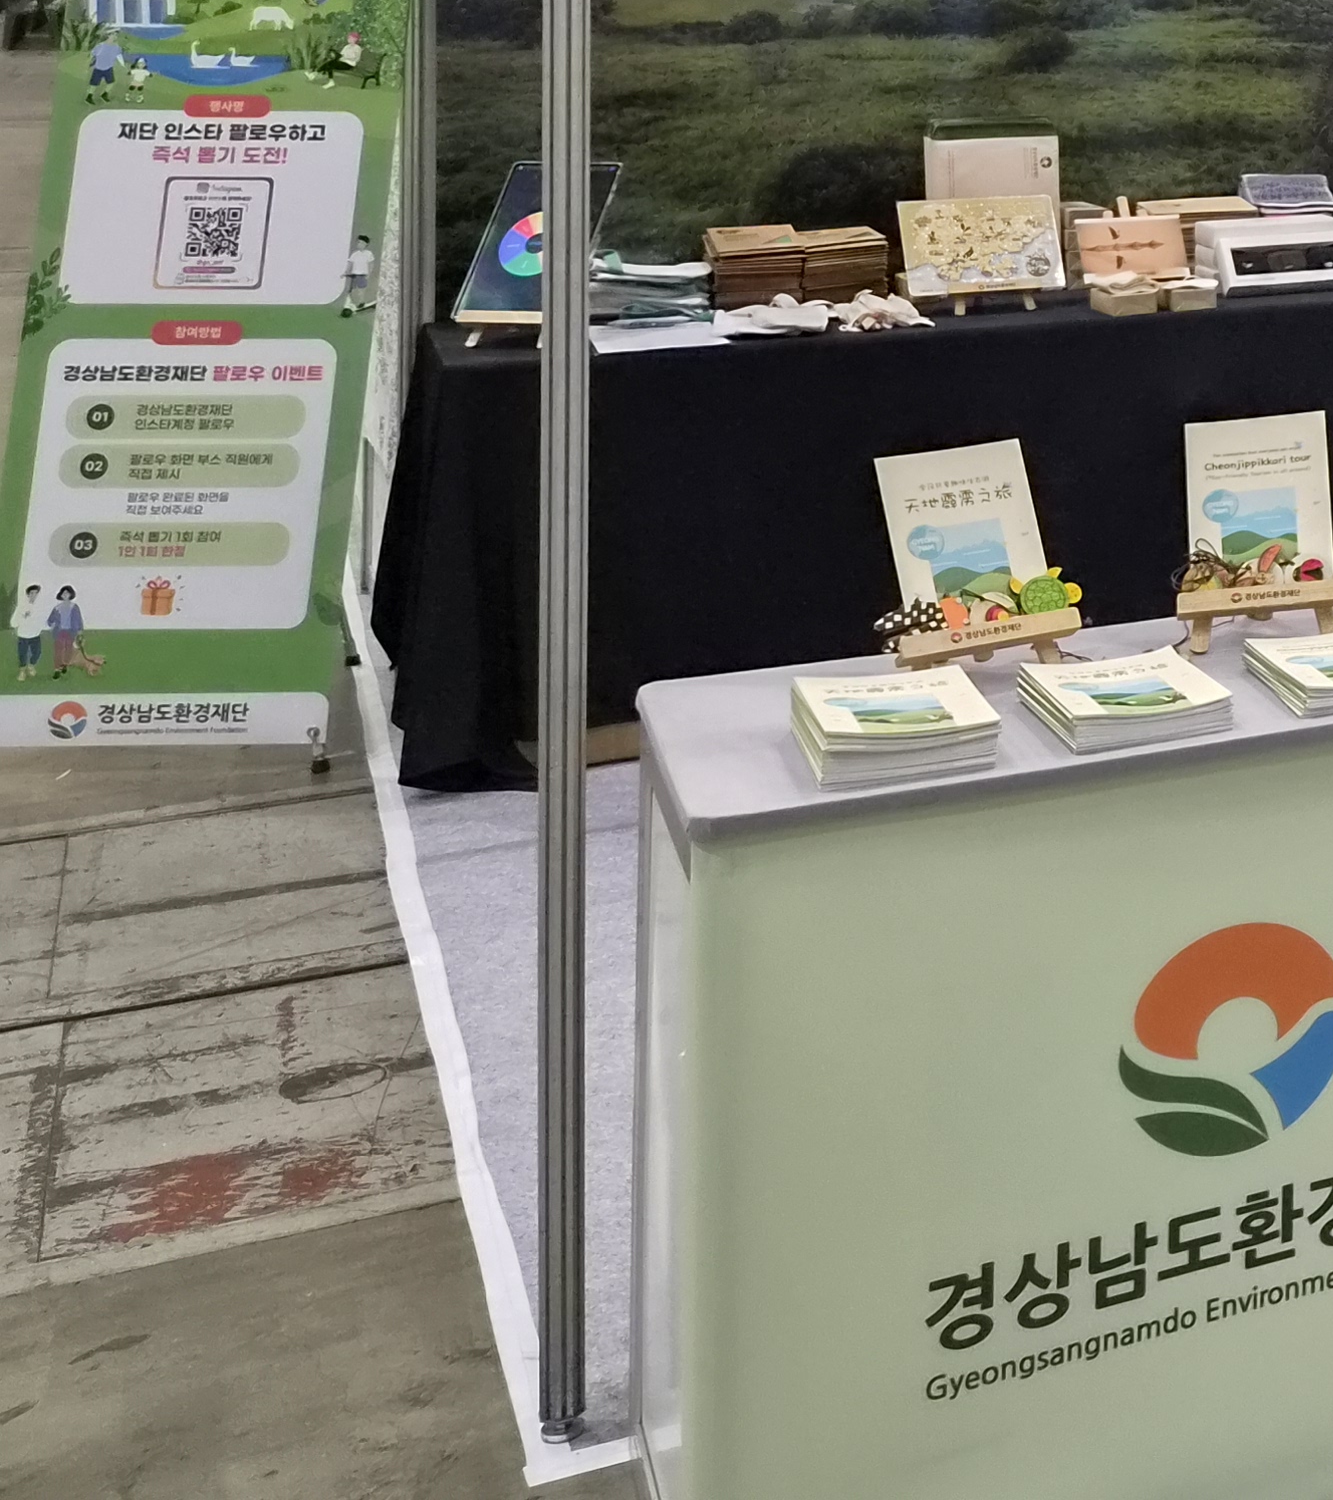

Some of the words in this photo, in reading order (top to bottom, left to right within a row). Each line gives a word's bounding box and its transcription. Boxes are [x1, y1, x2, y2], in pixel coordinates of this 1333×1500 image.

[118, 122, 159, 142] 재단
[164, 122, 224, 142] 인스타
[228, 122, 327, 142] 팔로우하고
[151, 145, 191, 164] 즉석
[242, 146, 289, 165] 도전!
[62, 364, 208, 383] 경상남도환경재단
[212, 364, 266, 382] 팔로우
[271, 365, 324, 382] 이벤트
[91, 411, 109, 422] 01
[136, 403, 233, 417] 경상남도환경재단
[84, 460, 104, 472] 02
[73, 539, 93, 550] 03
[97, 701, 250, 726] 경상남도환경재단
[925, 1305, 1198, 1402] Gyeongsangnamdo
